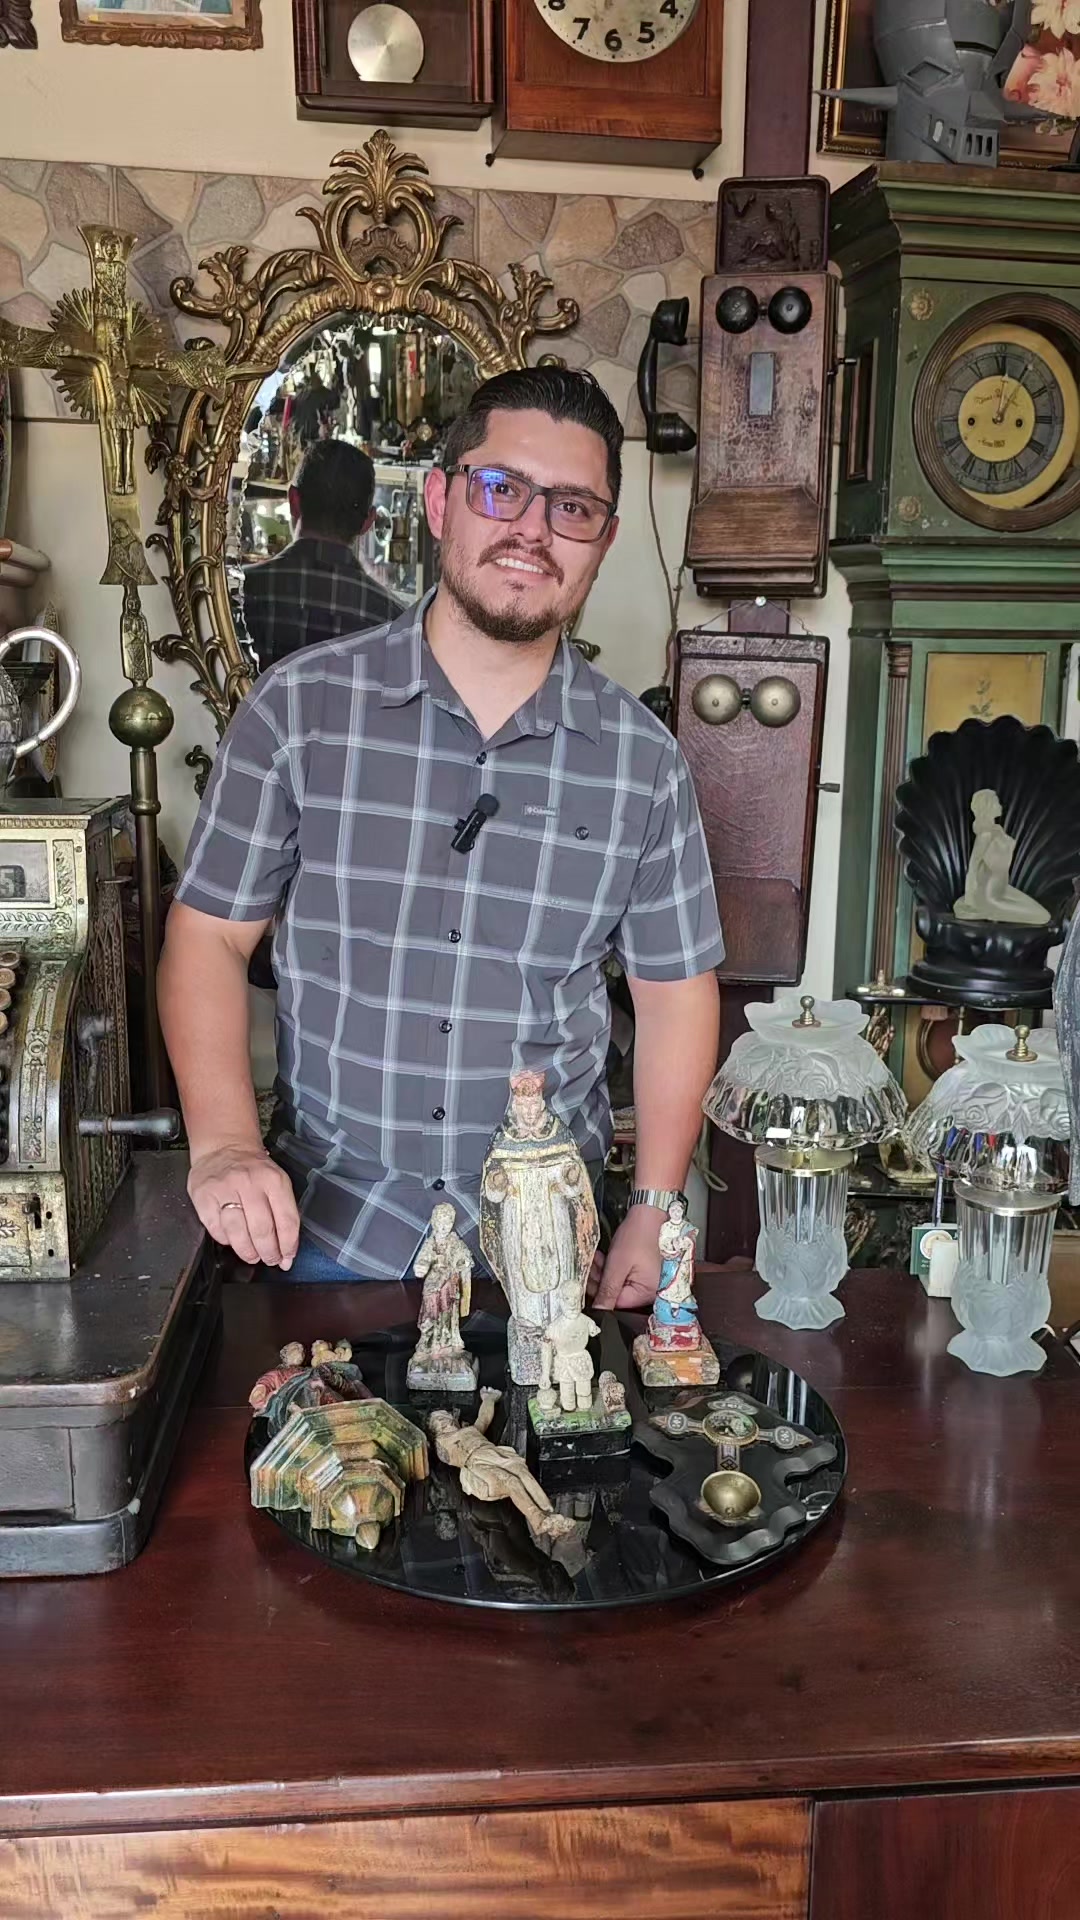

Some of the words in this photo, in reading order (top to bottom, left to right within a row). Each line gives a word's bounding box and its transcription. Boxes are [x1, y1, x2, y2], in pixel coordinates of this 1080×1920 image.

[659, 0, 679, 19] 4
[572, 17, 591, 40] 7
[604, 28, 623, 52] 6
[637, 21, 656, 44] 5
[0, 868, 15, 898] 5
